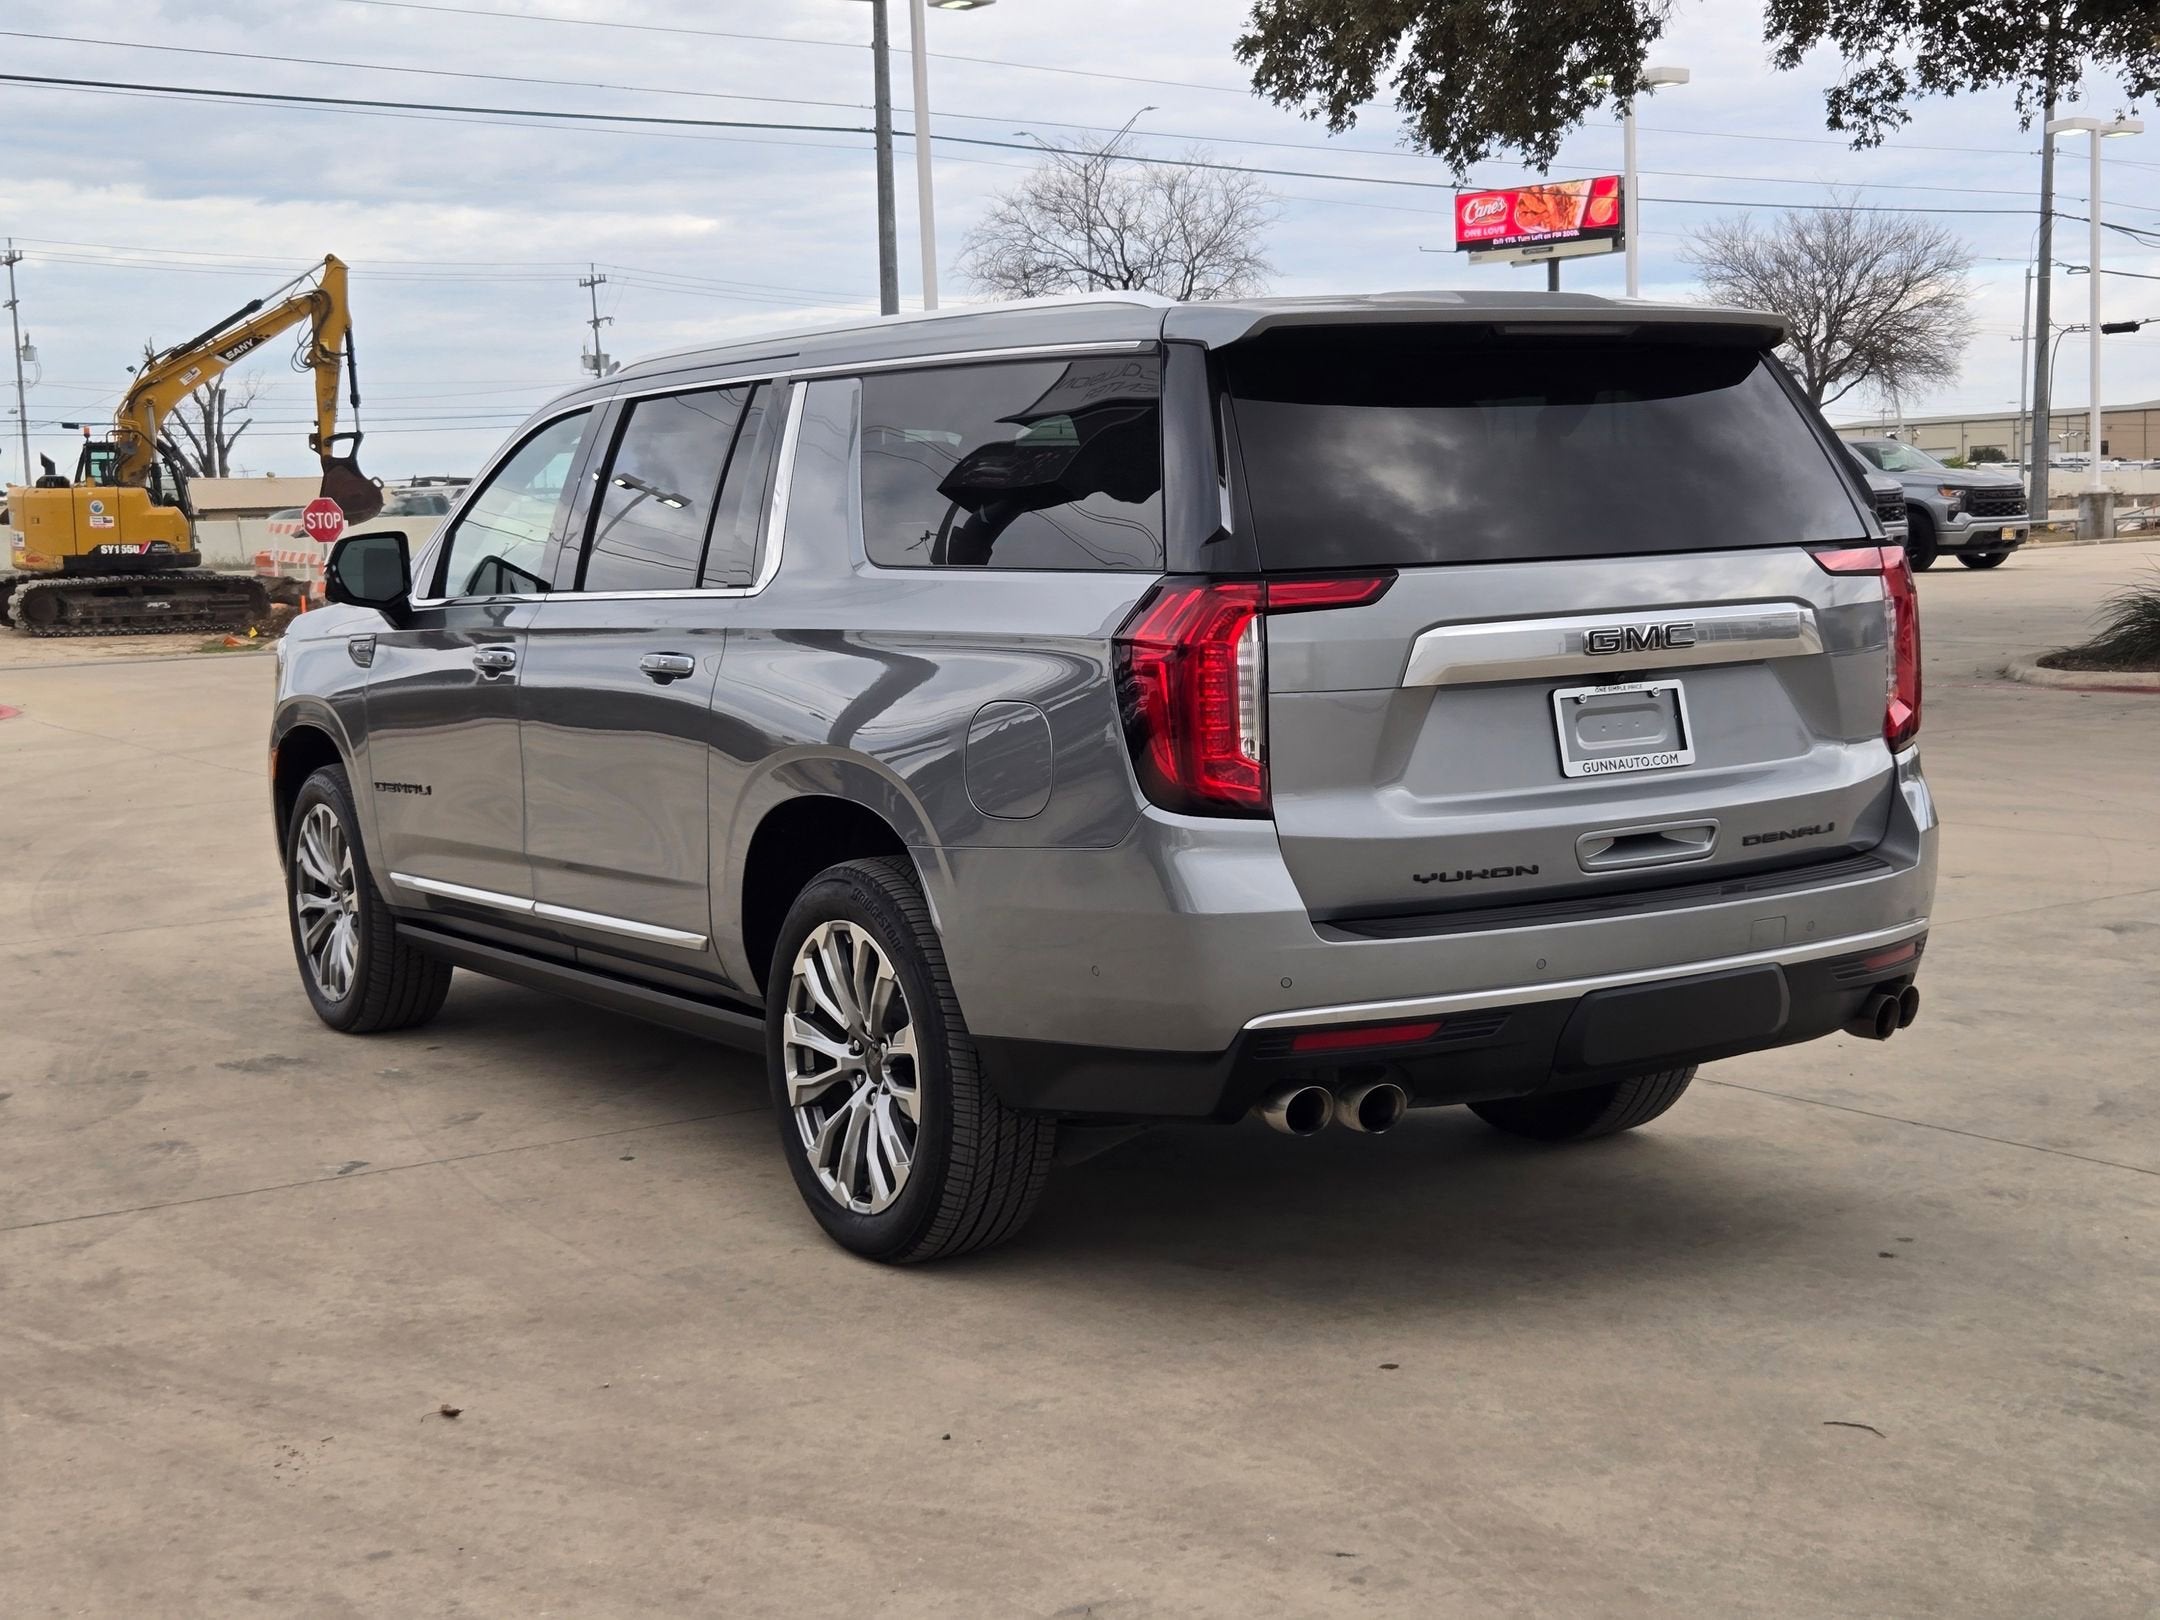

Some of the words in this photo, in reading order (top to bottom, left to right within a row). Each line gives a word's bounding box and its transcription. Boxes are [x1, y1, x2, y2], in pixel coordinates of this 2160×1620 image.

[1464, 229, 1482, 238] ONE
[1483, 226, 1505, 236] LOVE
[1531, 233, 1543, 241] Left
[225, 338, 254, 360] SANY
[306, 512, 341, 529] STOP
[100, 544, 140, 555] SY155U
[1583, 621, 1697, 655] GMC
[1582, 753, 1679, 773] GUNNAUTO.COM
[1742, 822, 1835, 846] DENALI
[1412, 864, 1540, 884] YUKON
[850, 887, 904, 955] BRIDGESTONE
